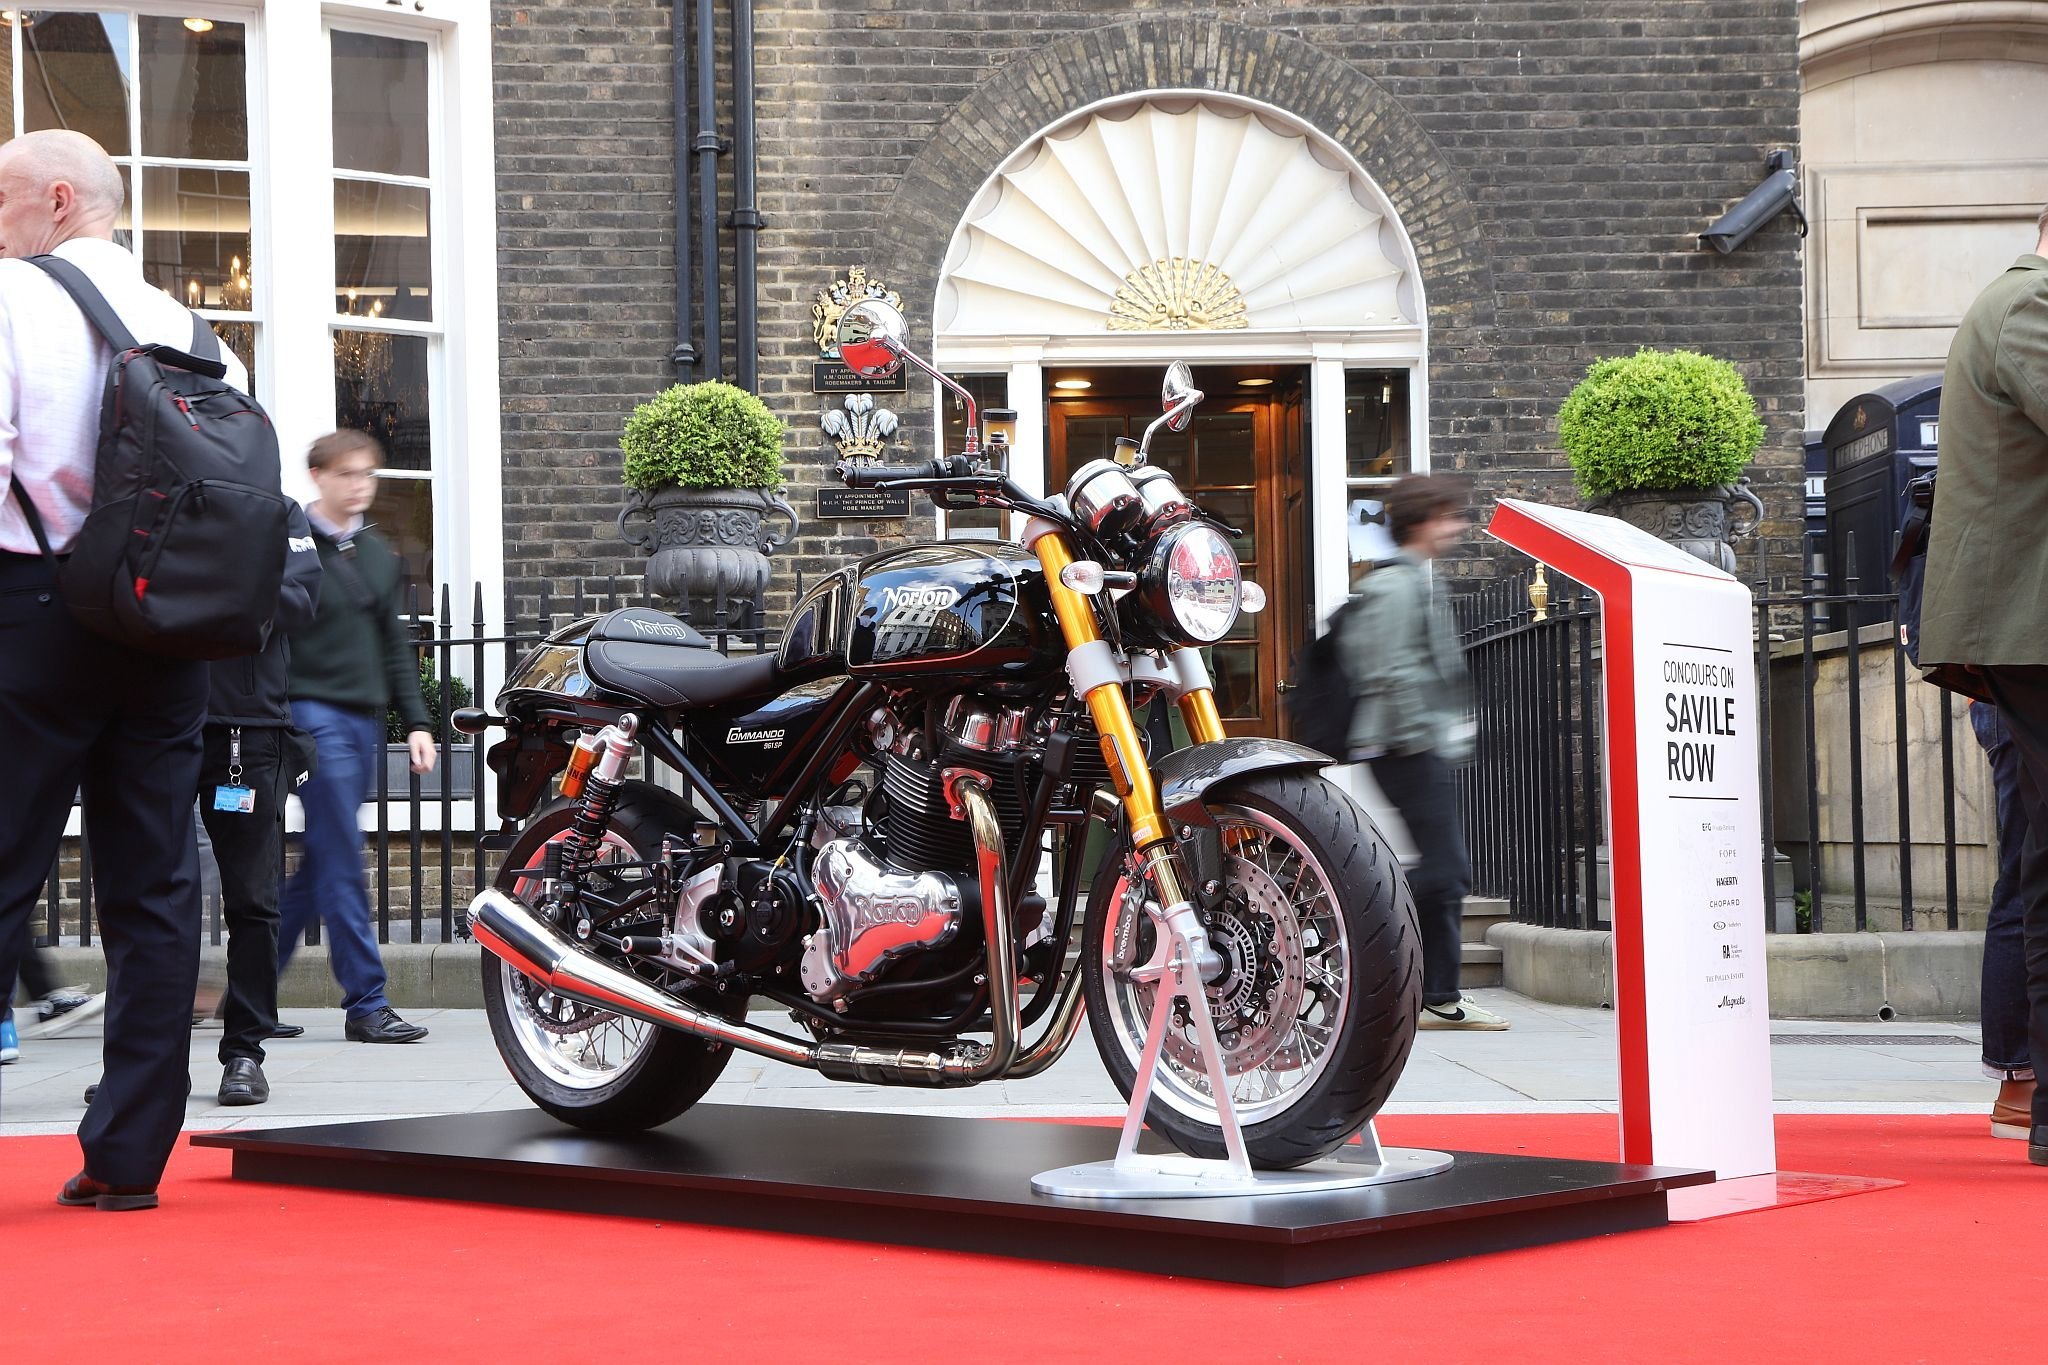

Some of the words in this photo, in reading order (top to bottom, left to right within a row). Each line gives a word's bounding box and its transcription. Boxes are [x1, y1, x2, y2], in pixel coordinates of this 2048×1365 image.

[1838, 428, 1888, 467] TELEPHONE
[883, 585, 959, 613] Norton
[623, 618, 687, 640] Norton
[1664, 660, 1718, 687] CONCOURS
[1721, 666, 1734, 689] ON
[1665, 692, 1736, 737] SAVILE
[726, 726, 785, 744] COMMANDO
[1667, 741, 1715, 783] ROW
[1716, 876, 1738, 887] HAGERTY
[855, 893, 923, 928] Norton
[1709, 899, 1740, 908] CHOPARD
[1117, 914, 1132, 960] brembo
[1717, 995, 1746, 1009] Magneto
